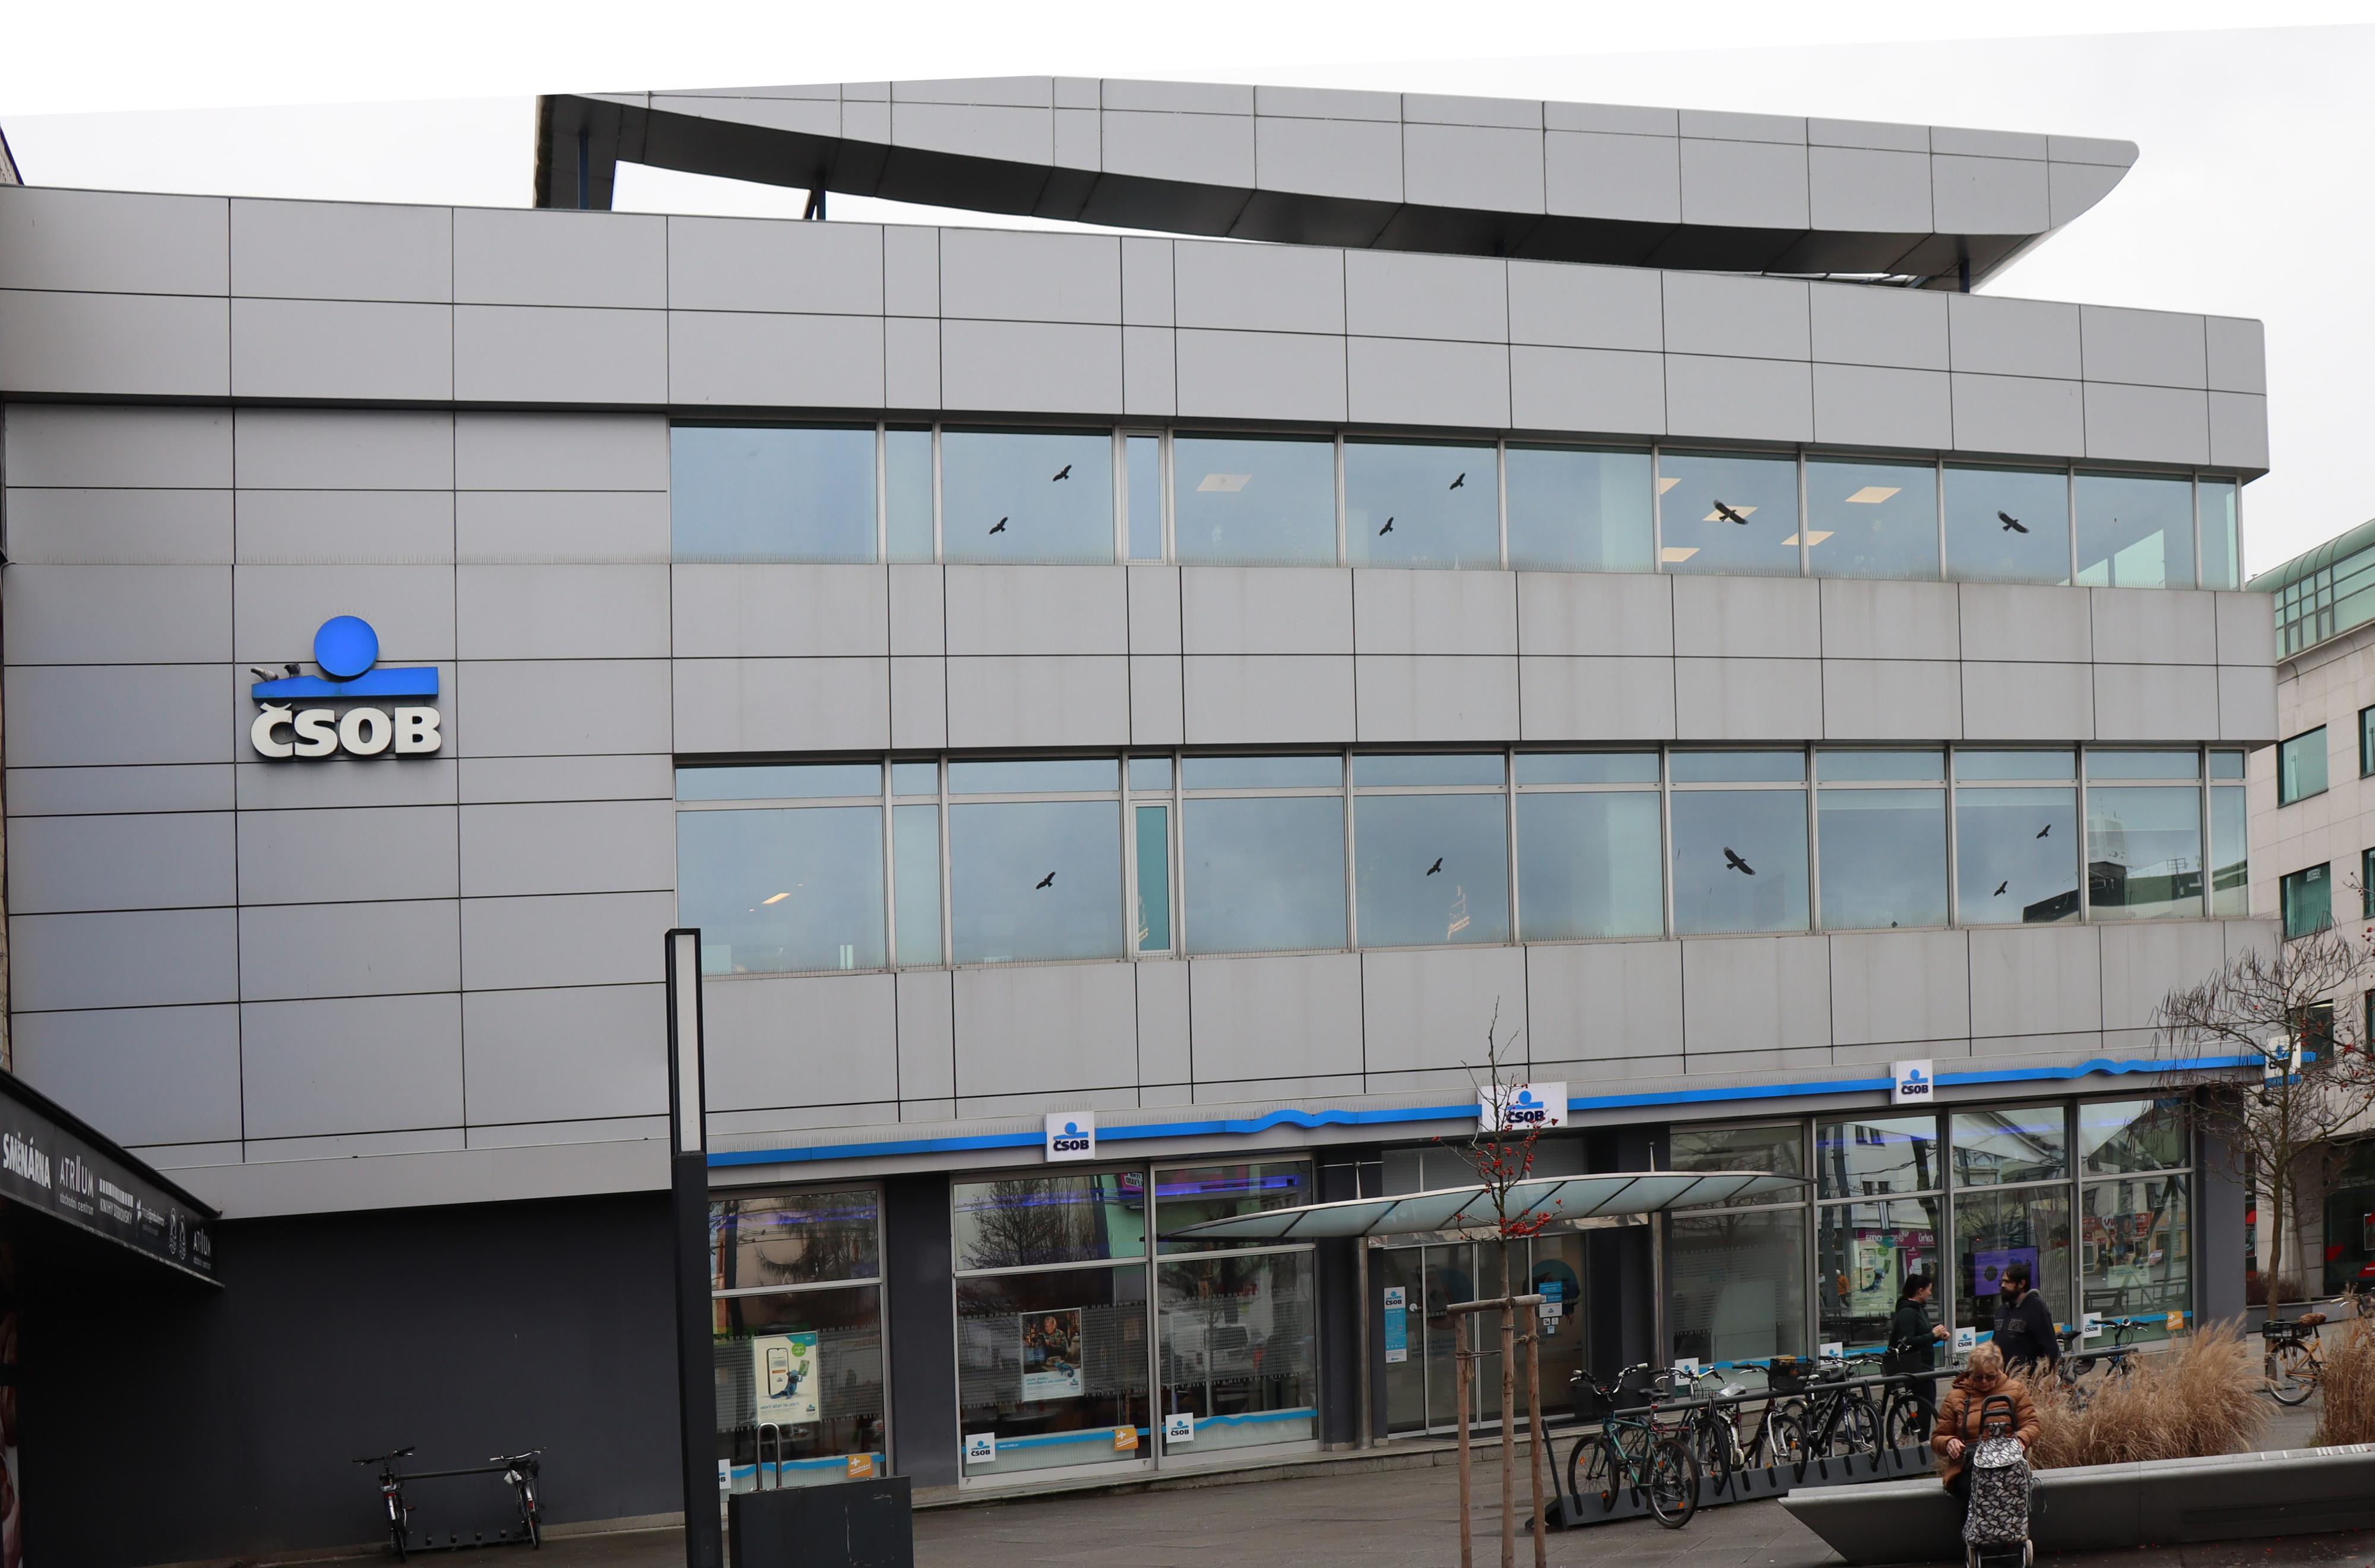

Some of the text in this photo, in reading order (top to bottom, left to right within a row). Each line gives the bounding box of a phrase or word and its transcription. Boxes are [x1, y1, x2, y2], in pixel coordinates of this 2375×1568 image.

[250, 702, 442, 758] ČSOB
[1901, 1085, 1928, 1095] ČSOB
[1506, 1110, 1544, 1123] ČSOB
[1053, 1139, 1089, 1151] ČSOB
[3, 1131, 51, 1189] SMĚNÁRNA
